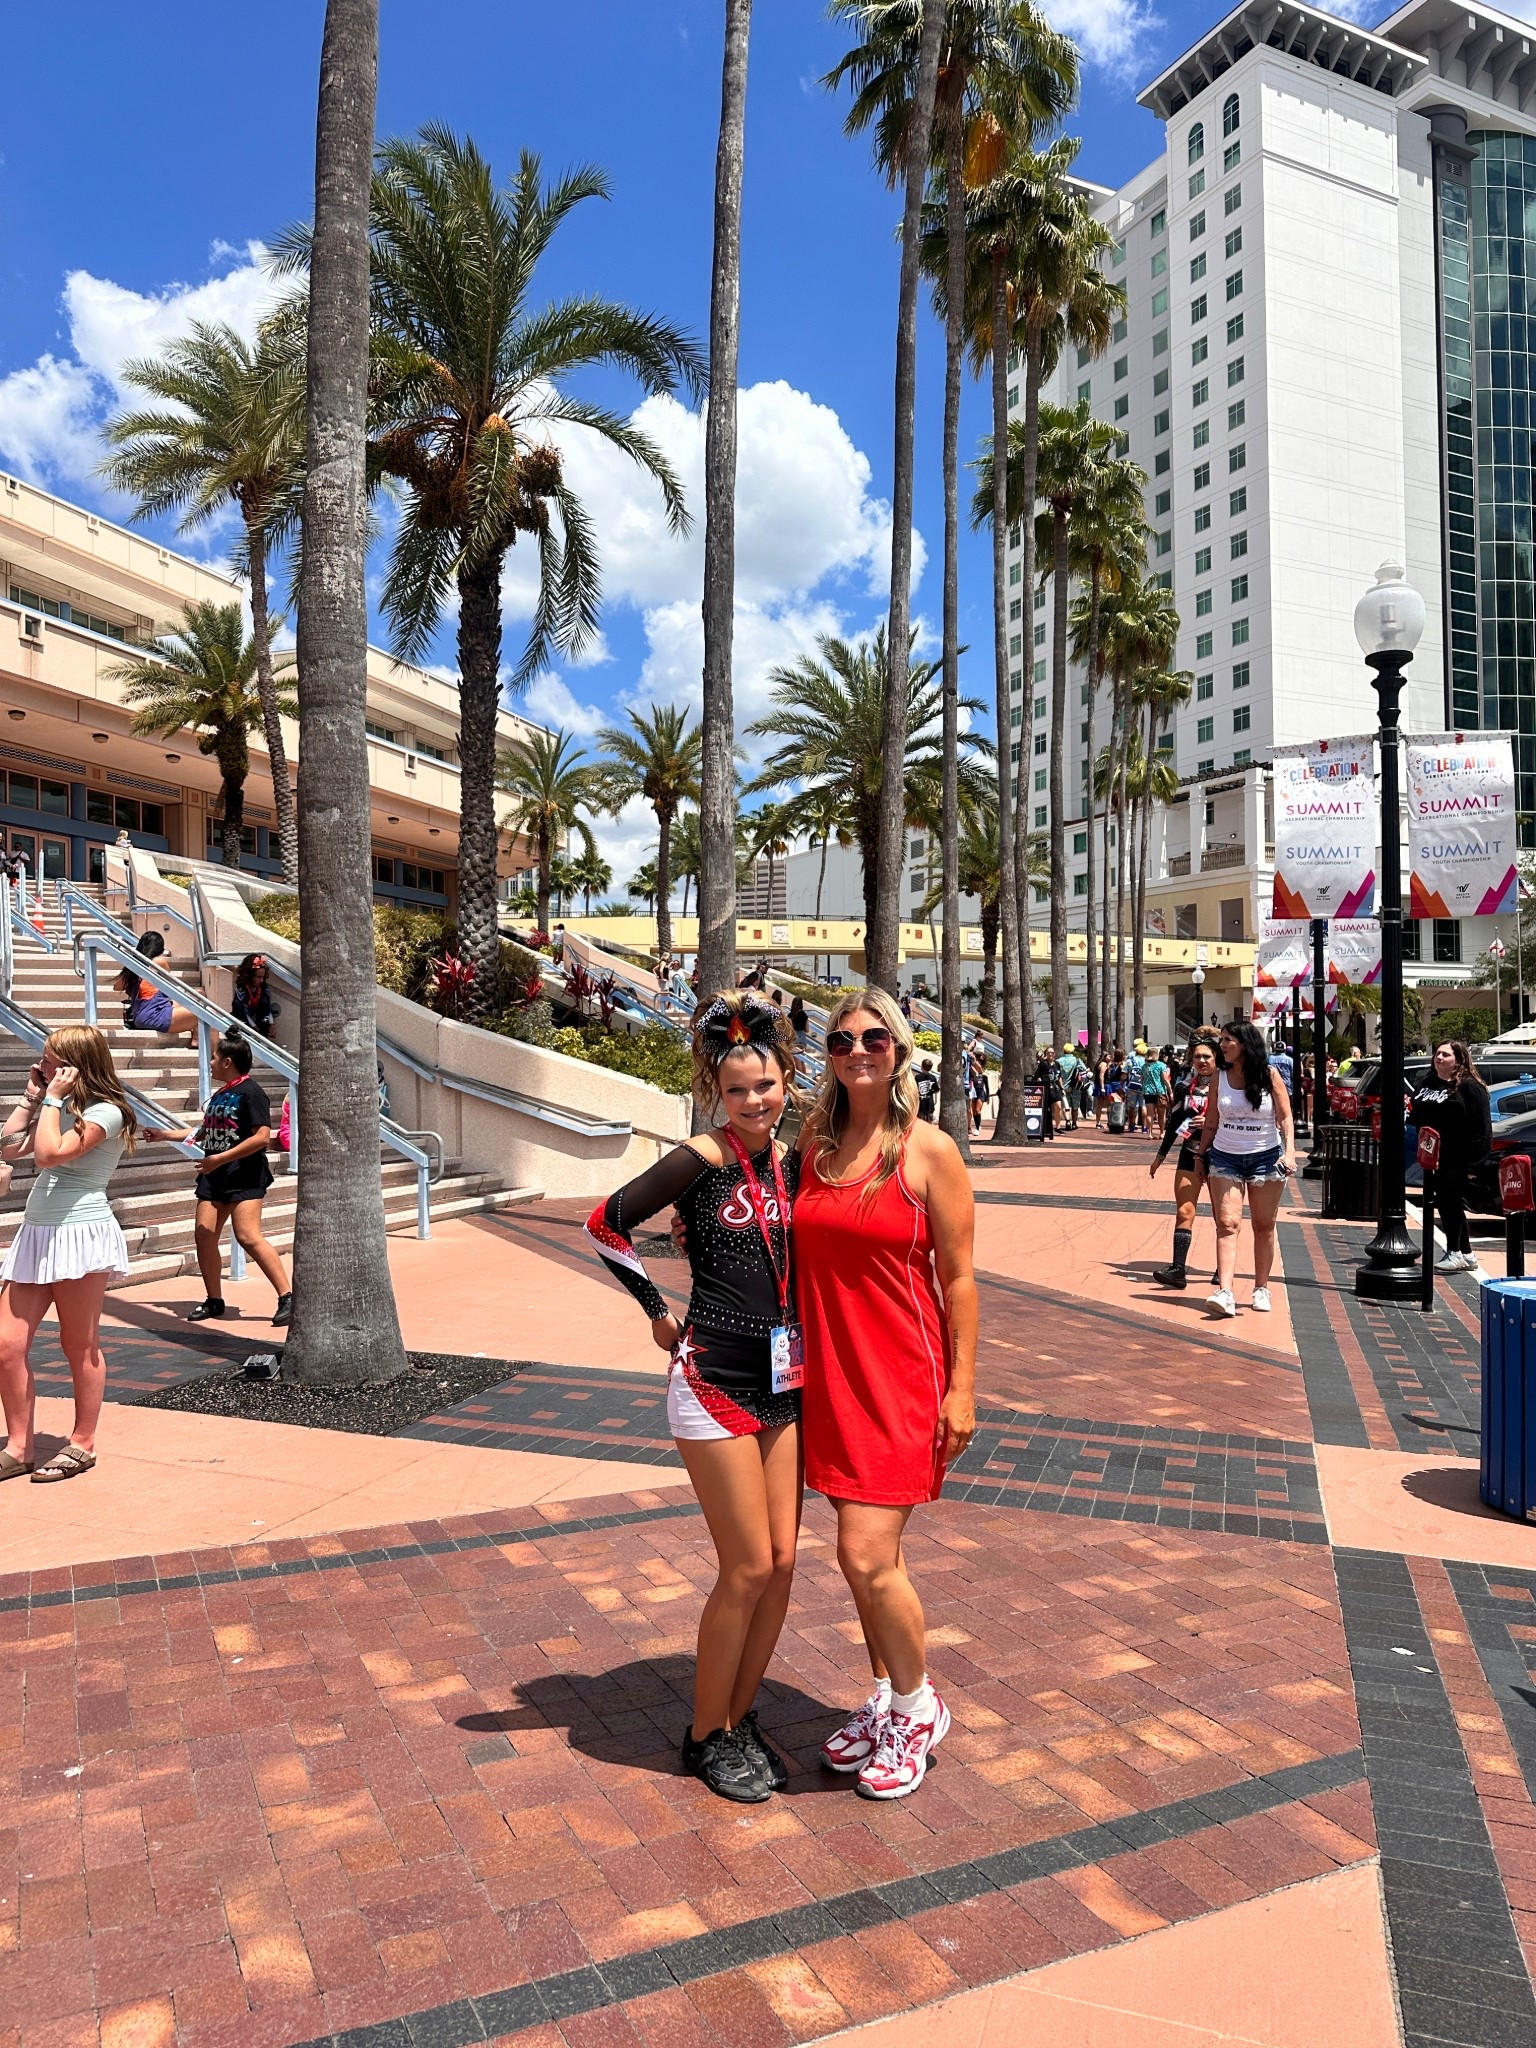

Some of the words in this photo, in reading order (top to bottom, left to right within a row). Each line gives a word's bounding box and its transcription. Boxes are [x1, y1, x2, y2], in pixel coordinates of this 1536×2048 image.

[1290, 763, 1358, 781] CELEBRATION
[1424, 756, 1496, 774] CELEBRATION
[1286, 802, 1362, 816] SUMMIT
[1420, 794, 1501, 814] SUMMIT
[1418, 813, 1460, 821] RECREATIONAL
[1461, 809, 1505, 817] CHAMPIONSHIP
[1286, 846, 1362, 859] SUMMIT
[1421, 840, 1502, 859] SUMMIT
[1451, 856, 1492, 864] CHAMPIONSHIP
[1265, 928, 1303, 936] SUMMIT
[1334, 923, 1375, 931] SUMMIT
[775, 1369, 802, 1385] ATHLETE
